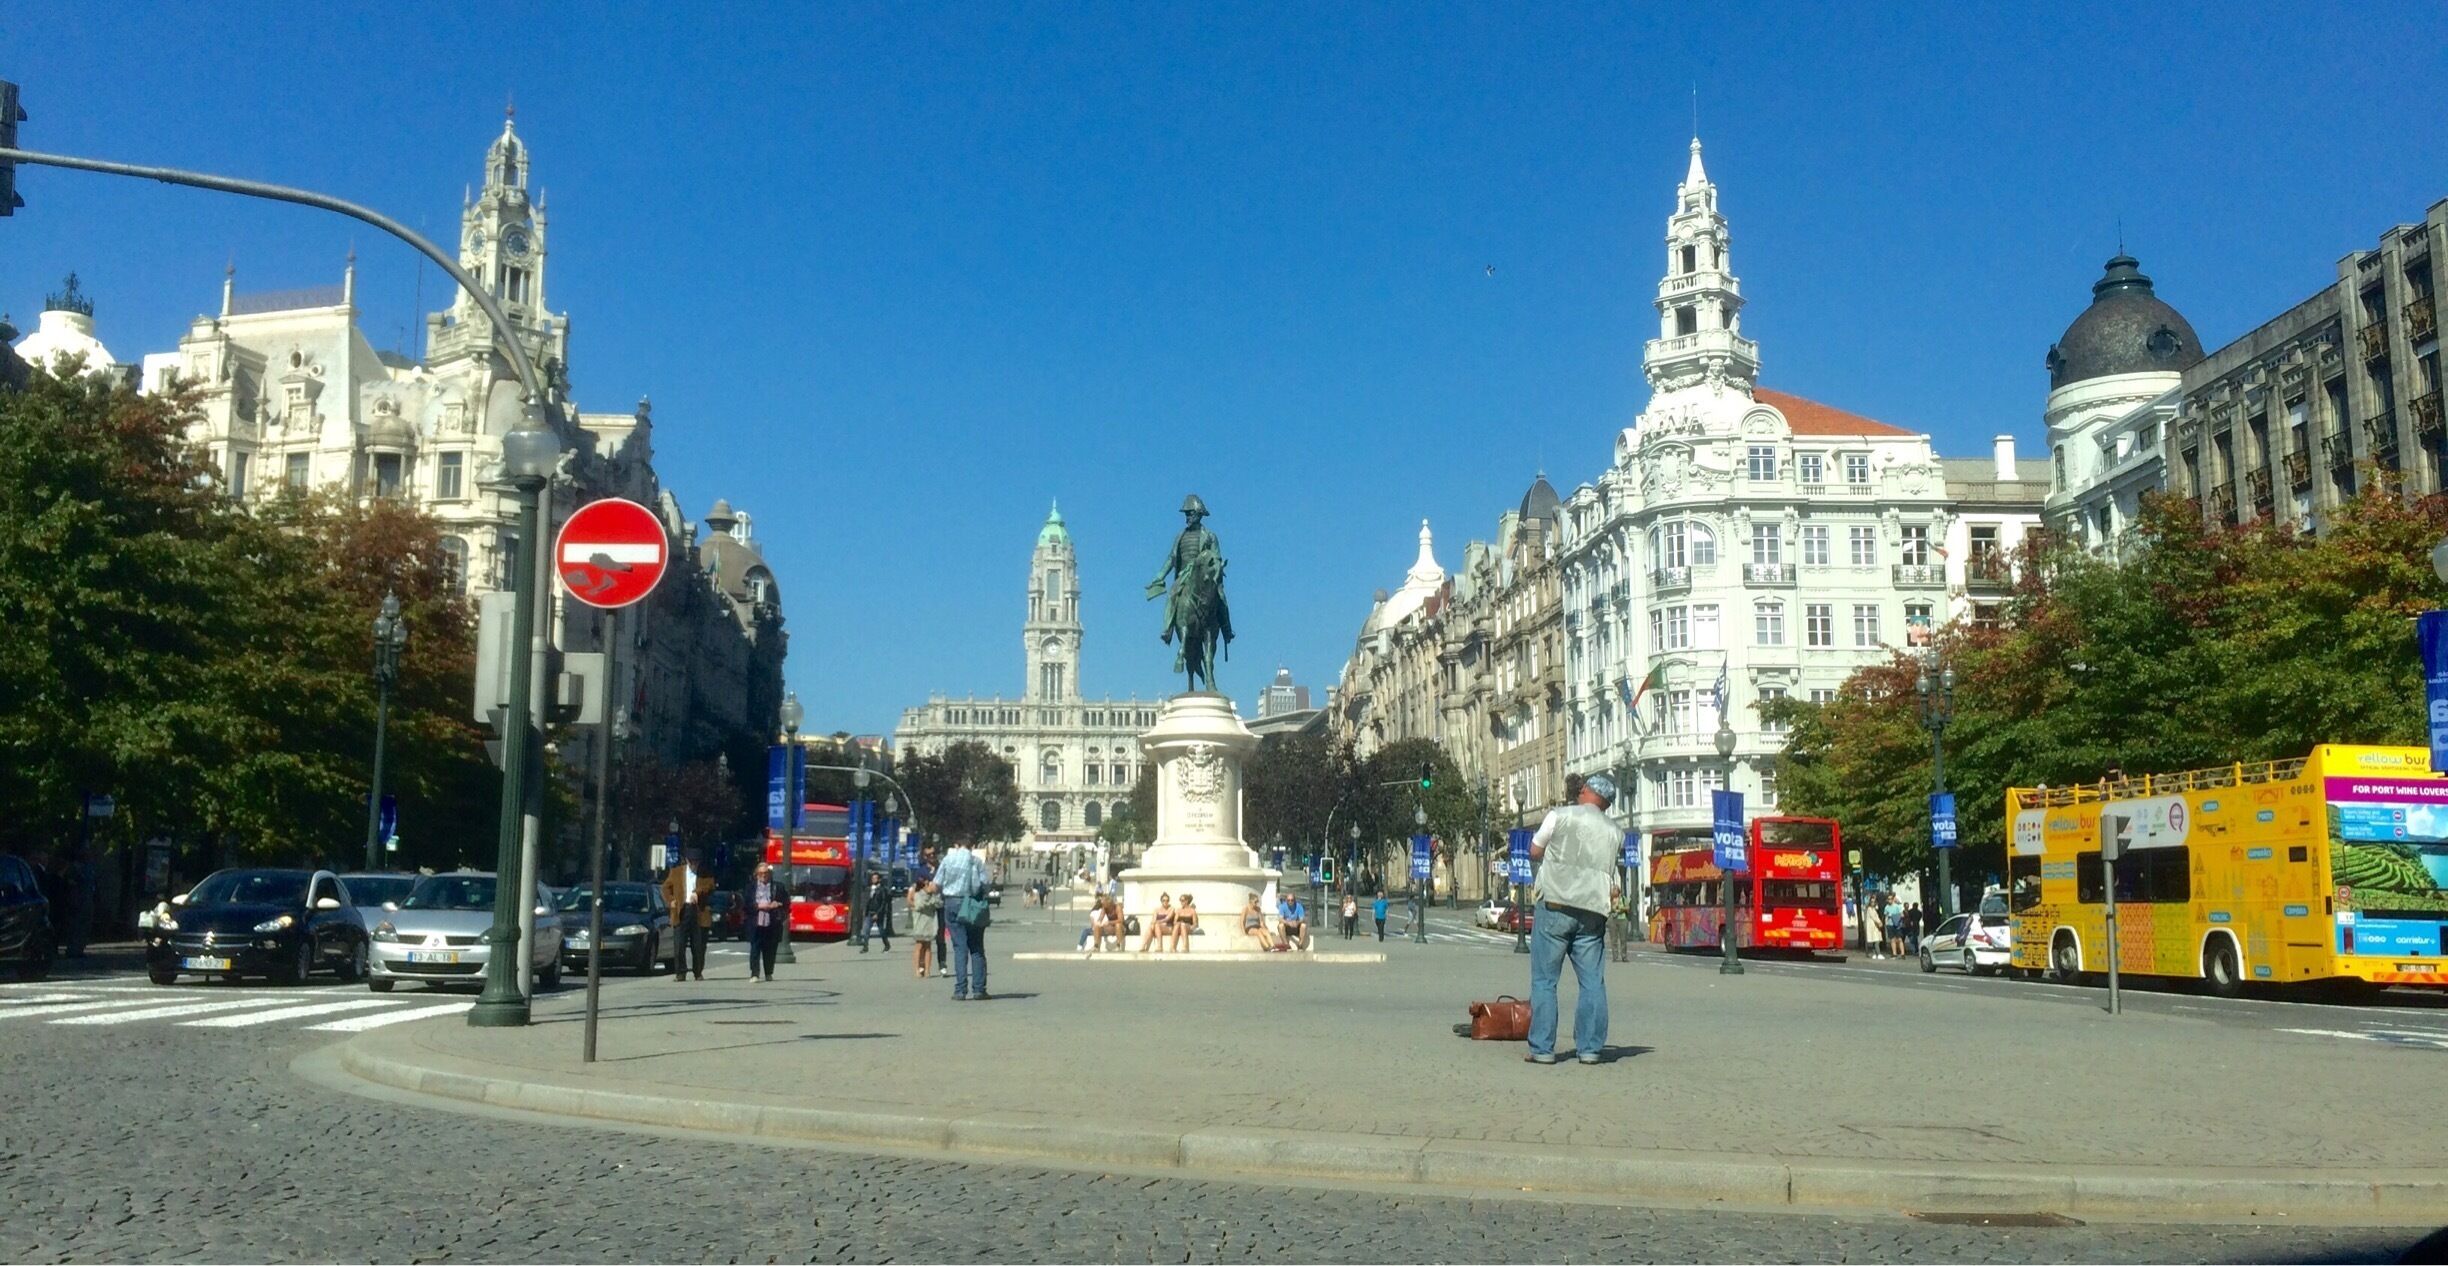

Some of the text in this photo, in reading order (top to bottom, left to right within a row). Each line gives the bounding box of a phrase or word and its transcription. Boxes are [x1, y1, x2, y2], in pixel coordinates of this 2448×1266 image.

[2404, 753, 2426, 765] bus
[2352, 784, 2448, 797] FOR PORT WINE LOVERS
[1932, 819, 1956, 831] vota
[1714, 831, 1744, 847] vota
[1511, 857, 1531, 868] voa
